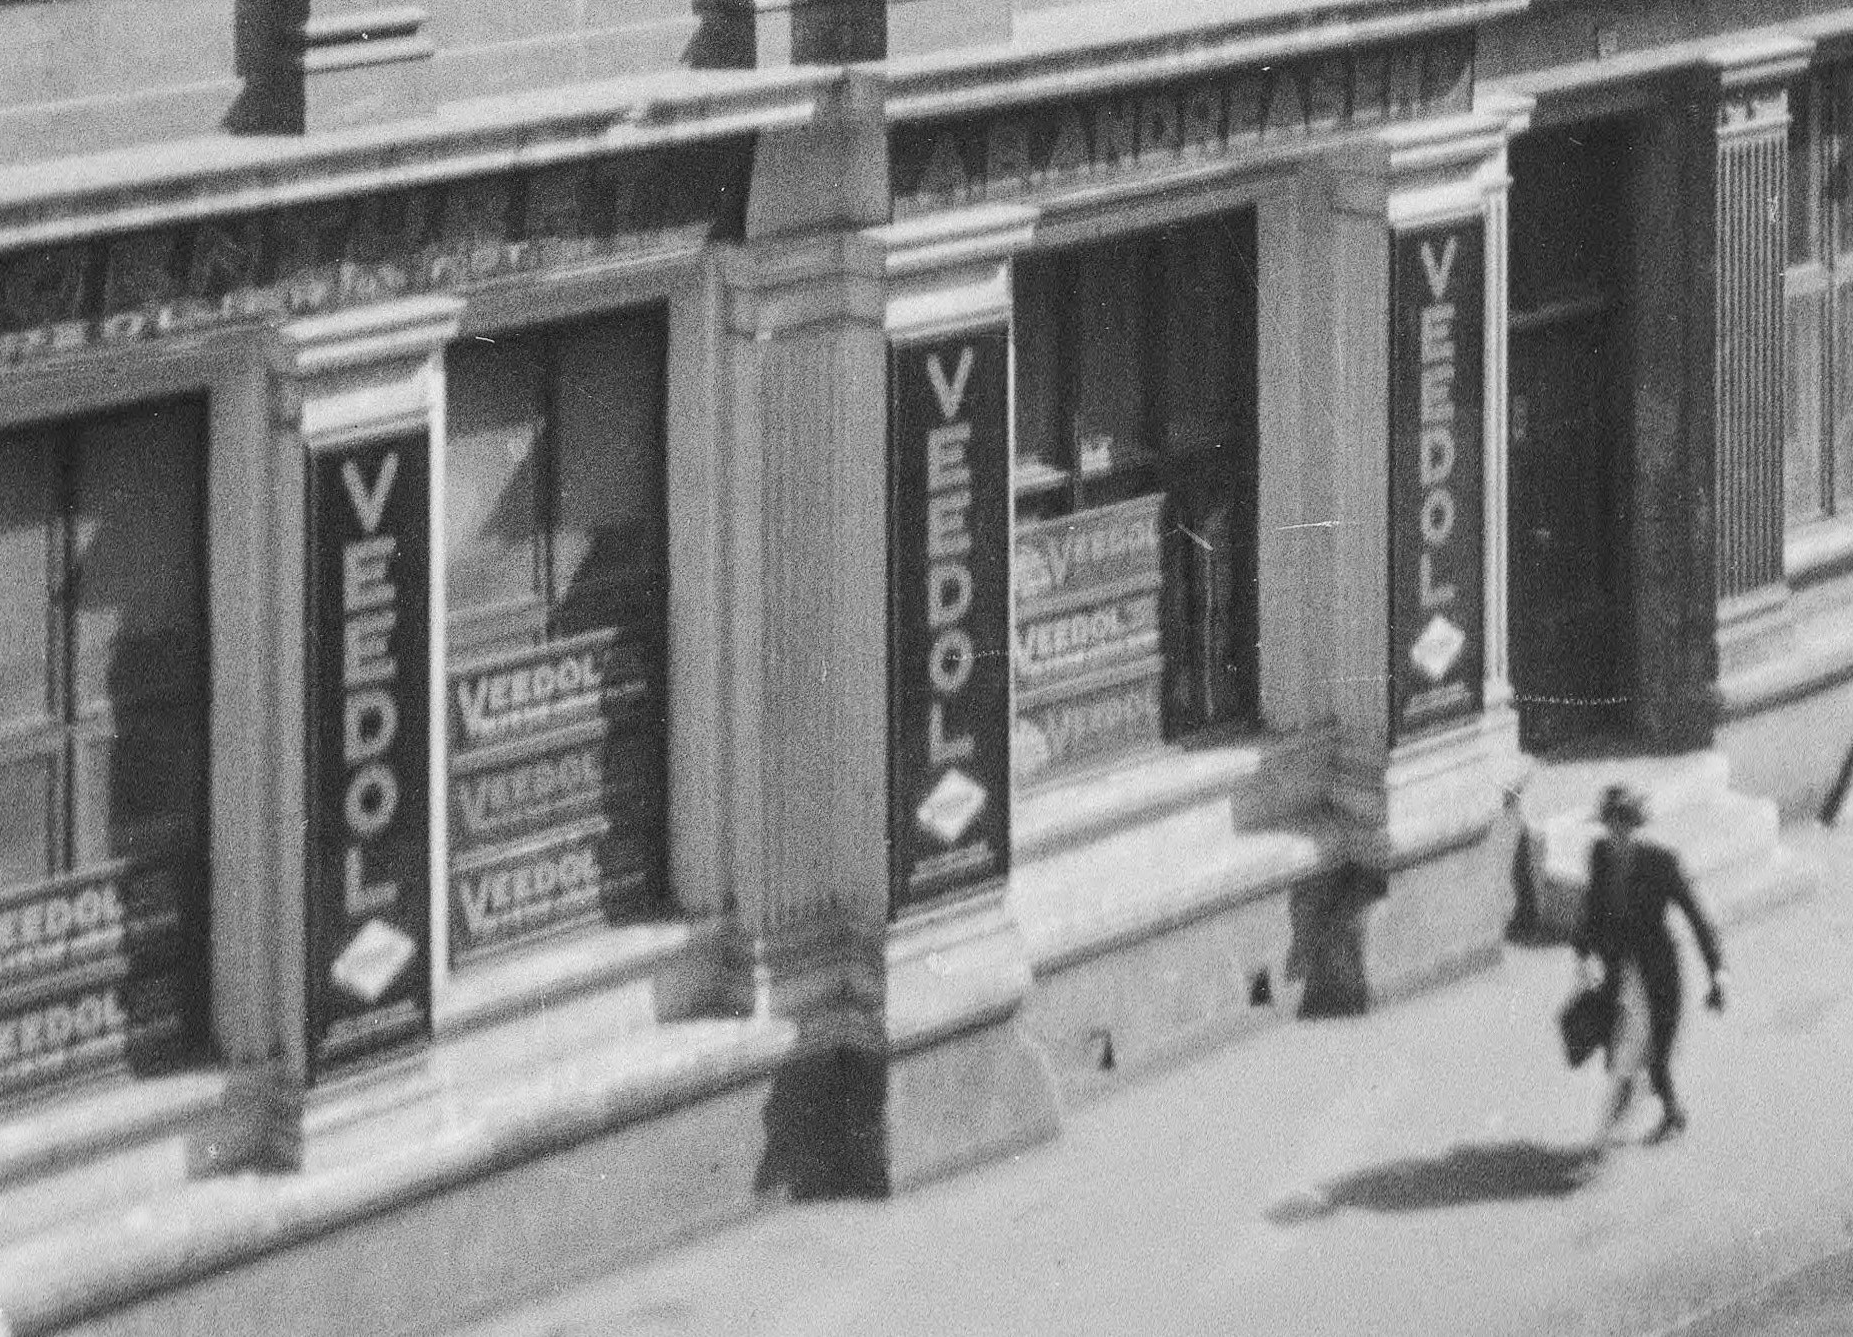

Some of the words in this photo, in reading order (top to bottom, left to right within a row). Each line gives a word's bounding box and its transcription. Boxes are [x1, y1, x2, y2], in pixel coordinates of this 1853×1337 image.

[926, 346, 974, 764] VEEDOL
[1419, 234, 1457, 608] VEEDOL
[343, 452, 399, 913] VEEDOL
[458, 653, 602, 735] VEEDOL
[459, 848, 601, 933] VEEDOL
